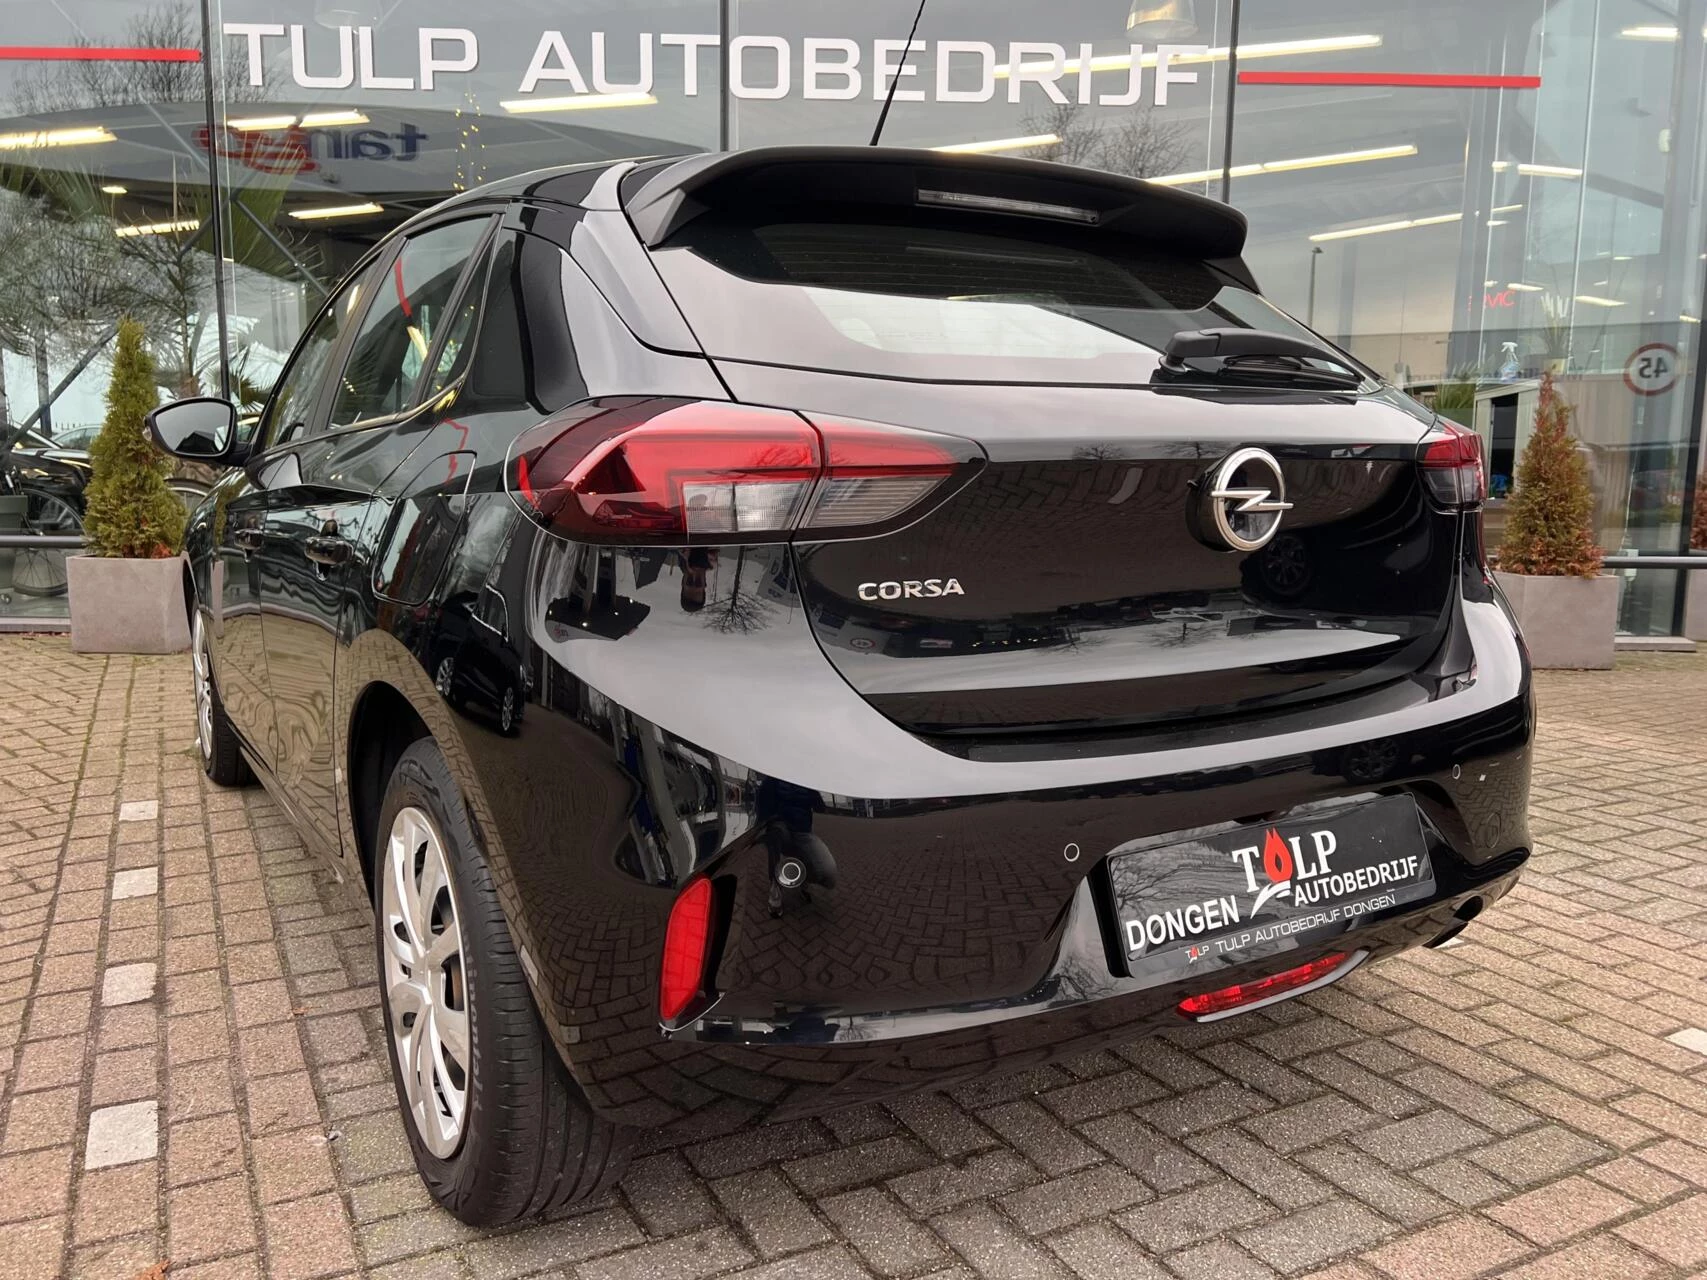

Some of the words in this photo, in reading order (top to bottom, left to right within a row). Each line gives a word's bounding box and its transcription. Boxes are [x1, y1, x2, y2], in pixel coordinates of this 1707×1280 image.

[223, 23, 479, 91] TULP
[518, 30, 1208, 106] AUTOBEDRIJF
[857, 577, 966, 601] CORSA
[1126, 894, 1241, 952] DONGEN
[1293, 855, 1419, 907] AUTOBEDRIJF
[1215, 933, 1251, 954] TULP
[1255, 908, 1341, 943] AUTOBEDRIJF
[1344, 893, 1397, 918] DONGEN
